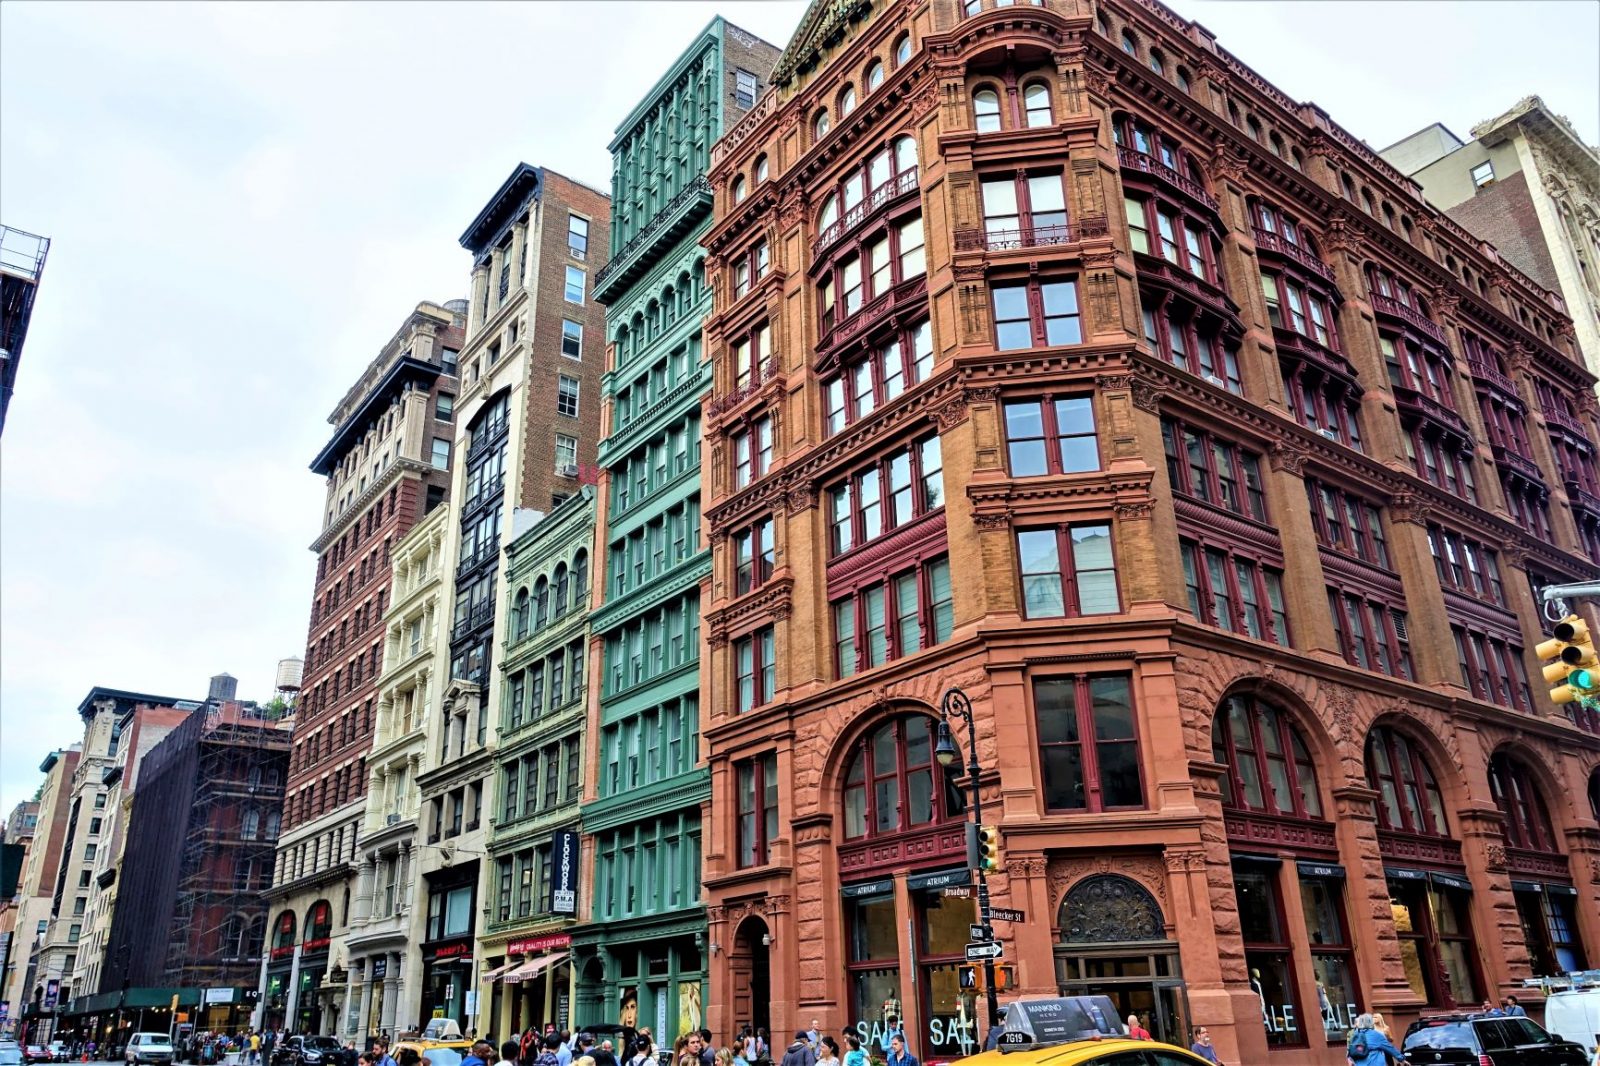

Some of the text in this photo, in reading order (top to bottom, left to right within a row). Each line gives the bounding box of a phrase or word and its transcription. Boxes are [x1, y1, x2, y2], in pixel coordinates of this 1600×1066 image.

[927, 876, 950, 886] ATRIUM
[857, 885, 876, 895] ATRIUM
[945, 887, 970, 898] Broadway
[990, 908, 1021, 922] Bleecker St
[1028, 1004, 1062, 1012] MANKIND
[1263, 1004, 1297, 1032] ALE
[1325, 1003, 1357, 1029] ALE
[1005, 1033, 1023, 1043] 7G19
